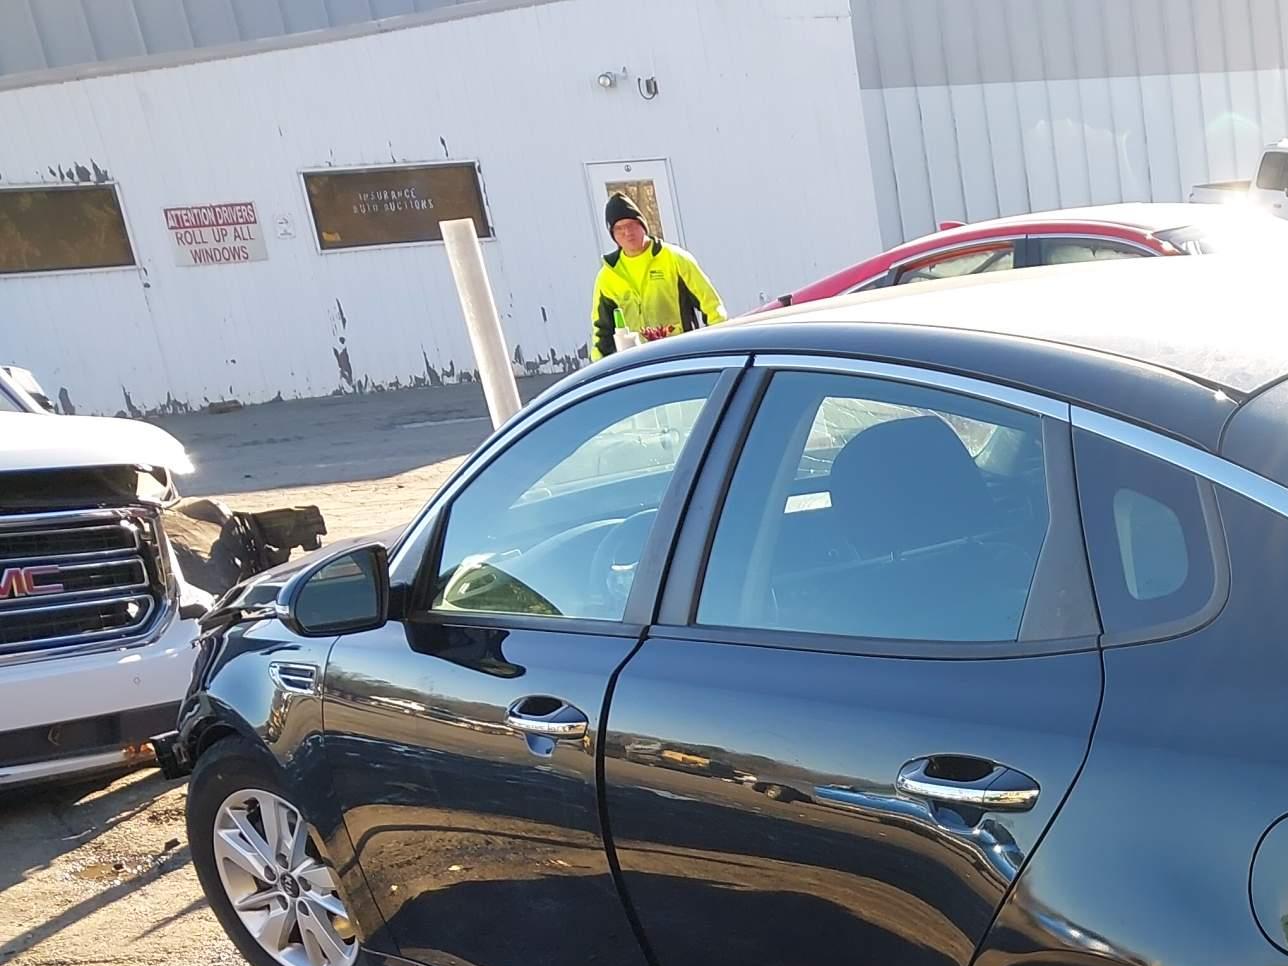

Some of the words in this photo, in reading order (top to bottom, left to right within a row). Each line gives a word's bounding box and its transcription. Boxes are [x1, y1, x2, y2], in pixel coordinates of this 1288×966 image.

[359, 188, 417, 201] INSURANCE
[383, 198, 434, 212] AUCTIONS
[167, 207, 215, 228] ATTENTION
[215, 205, 255, 224] DRIVERS
[175, 229, 208, 246] ROLL
[212, 227, 228, 243] UP
[234, 225, 255, 241] ALL
[190, 245, 249, 264] WINDOWS
[0, 564, 64, 598] MC
